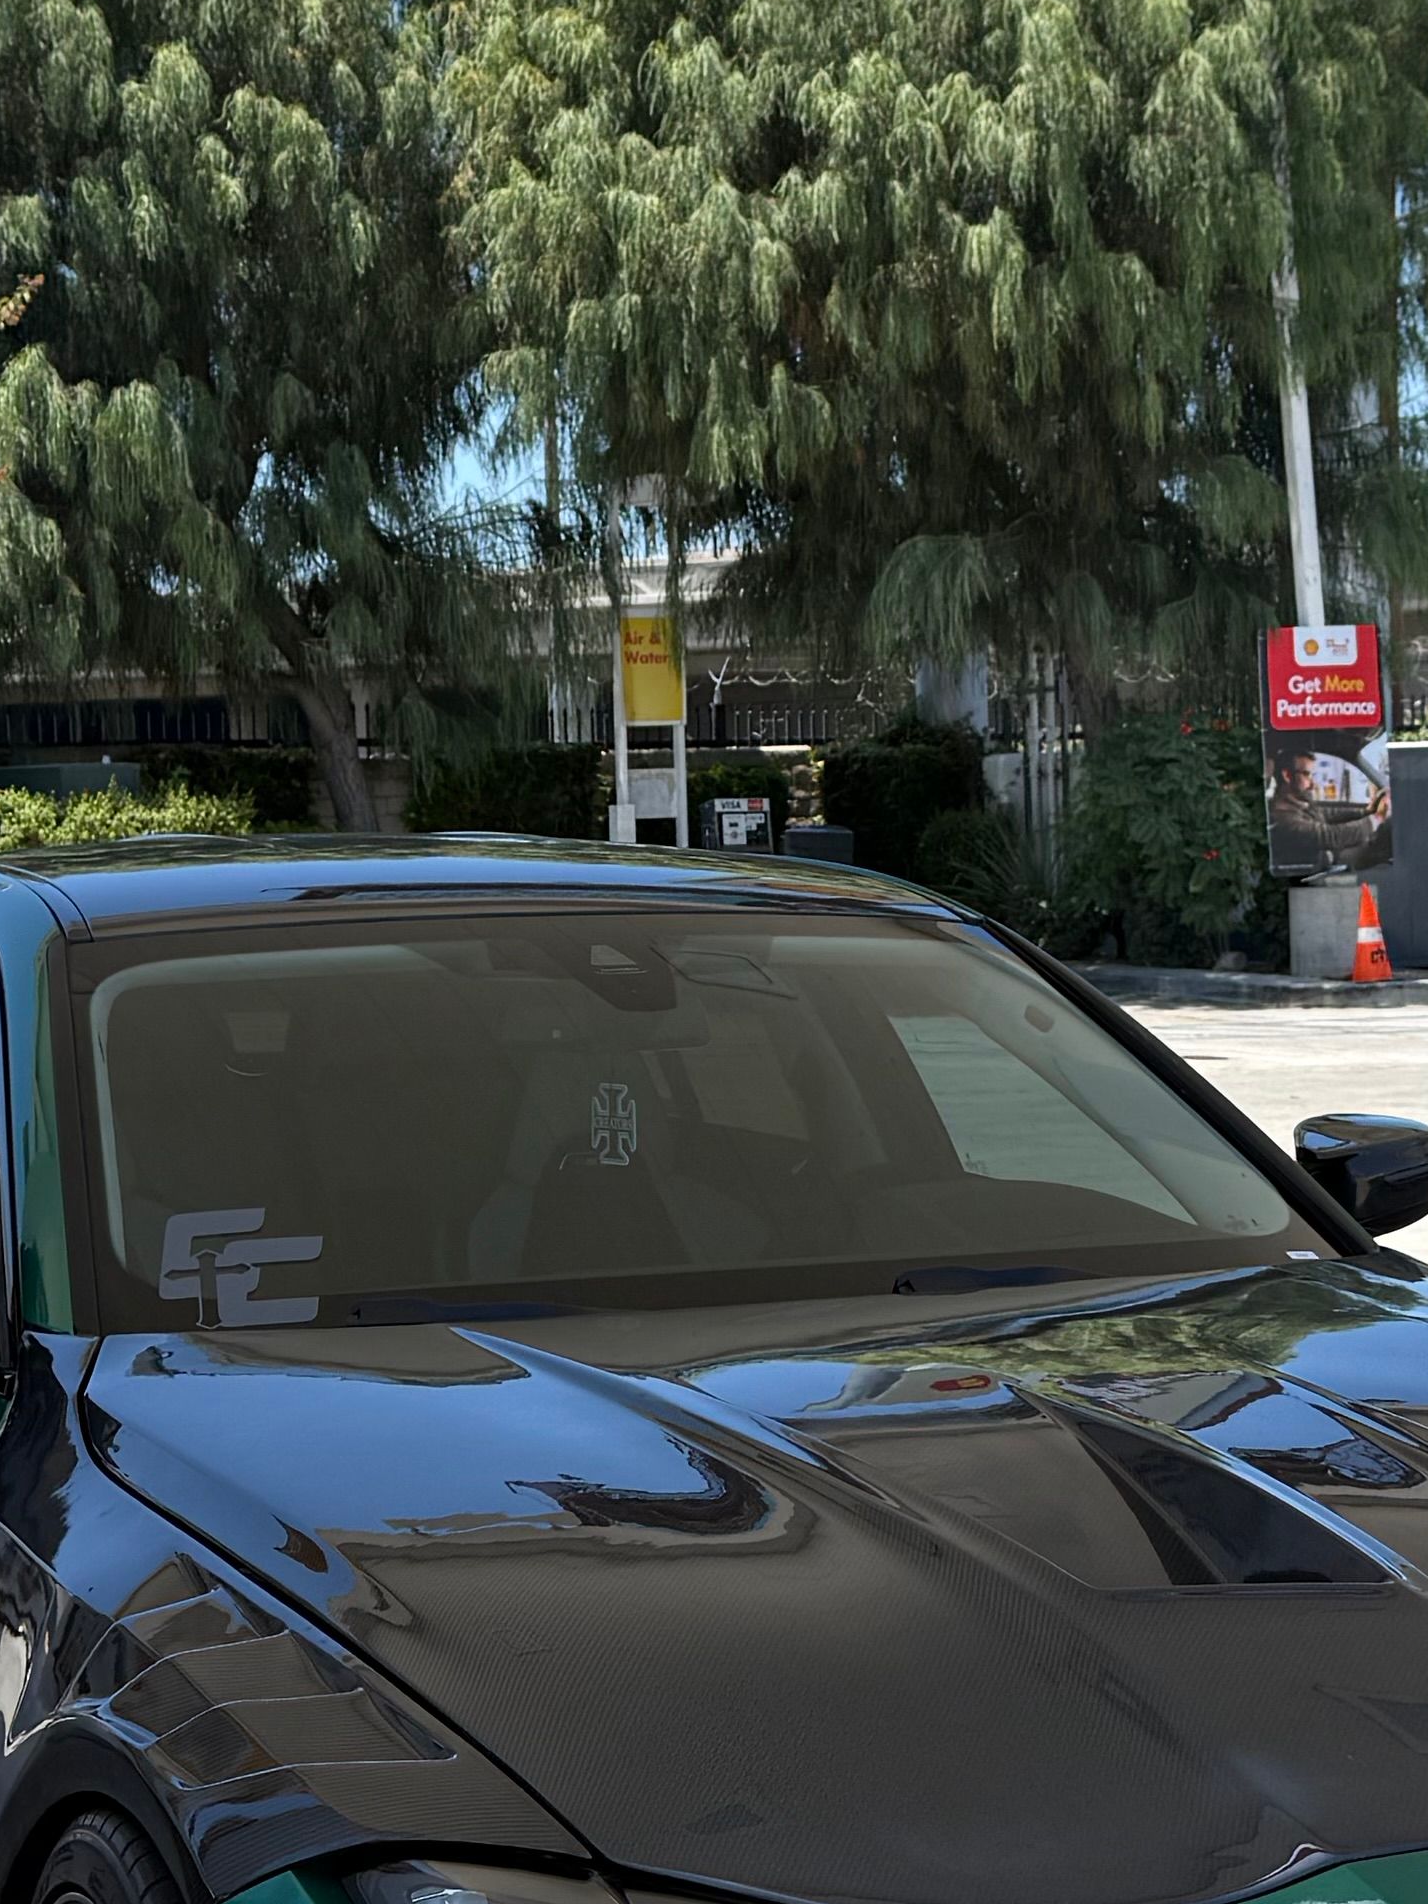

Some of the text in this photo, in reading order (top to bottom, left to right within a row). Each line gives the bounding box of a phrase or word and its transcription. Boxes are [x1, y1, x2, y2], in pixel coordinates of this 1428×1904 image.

[624, 632, 662, 646] Air &
[625, 650, 669, 664] Water
[1288, 675, 1365, 694] Get More
[1276, 696, 1375, 718] Performance
[721, 800, 741, 809] VISA
